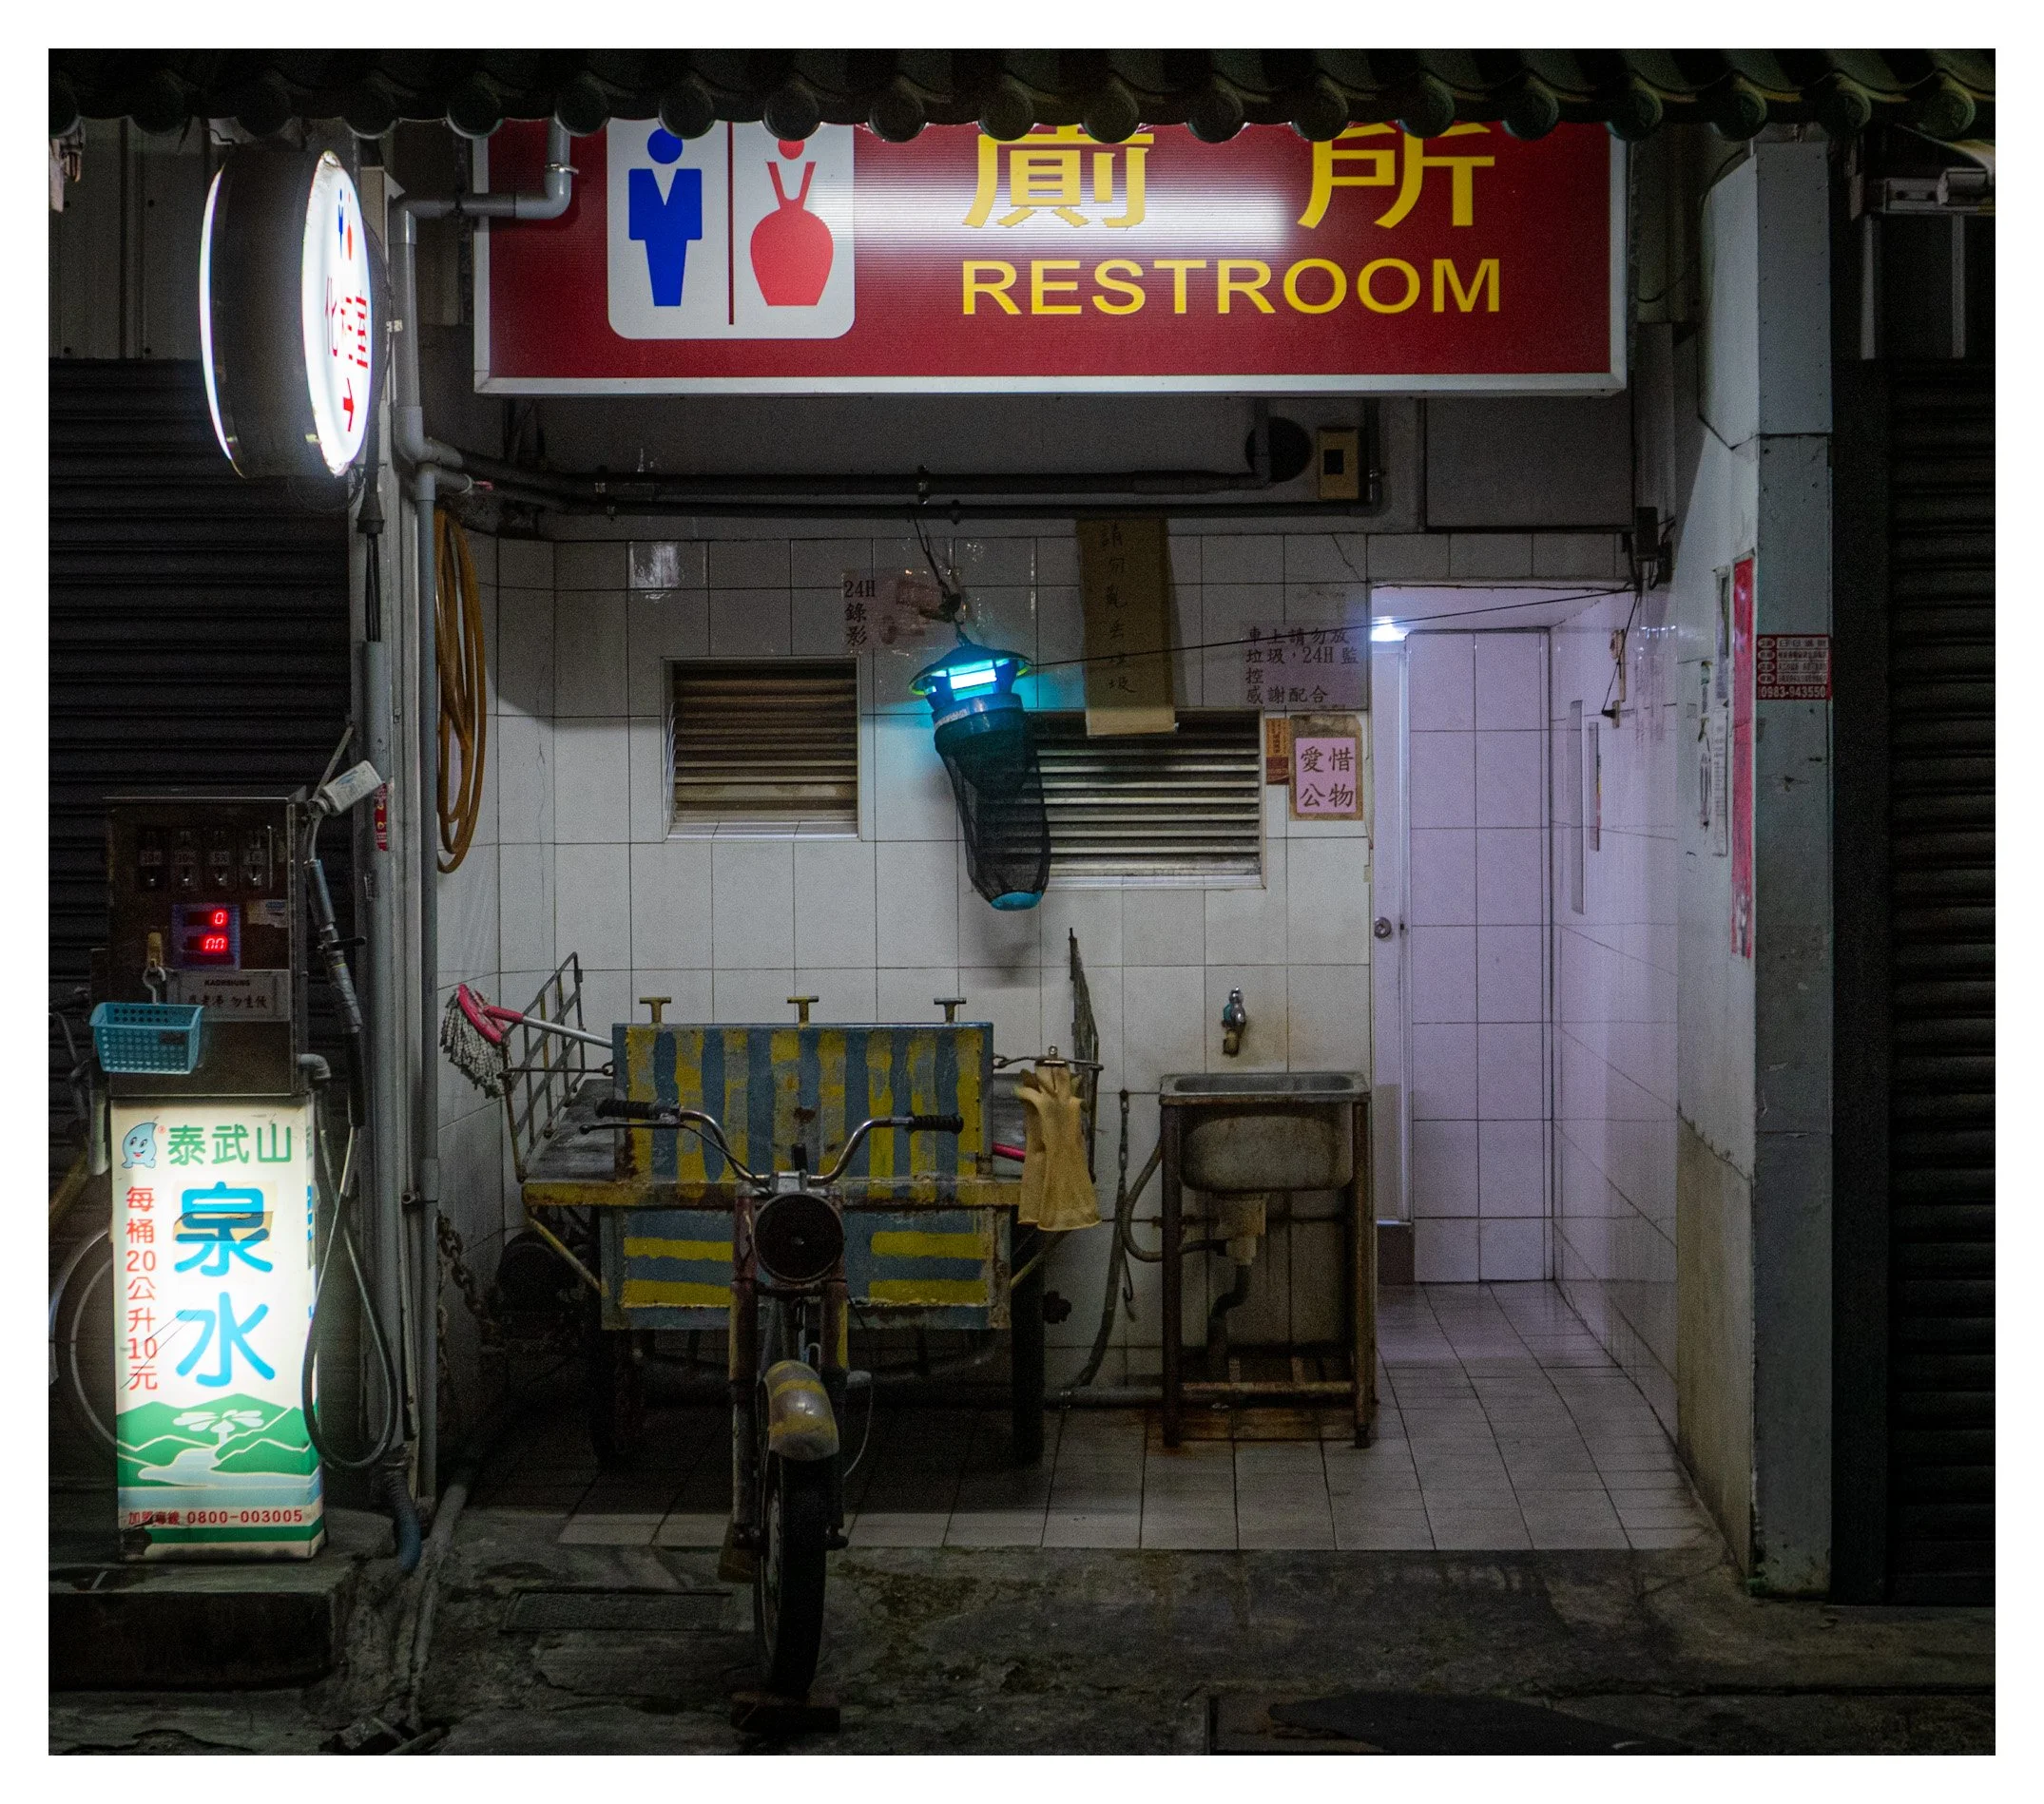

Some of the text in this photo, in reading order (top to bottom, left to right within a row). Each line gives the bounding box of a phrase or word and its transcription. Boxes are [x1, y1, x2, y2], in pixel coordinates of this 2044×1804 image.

[963, 259, 1501, 316] RESTROOM
[843, 579, 876, 598] 24H
[1246, 685, 1328, 704] 感謝配合
[1761, 684, 1826, 699] 0983-943550
[1300, 744, 1355, 774] 愛惜
[1300, 782, 1355, 808] 公物
[214, 912, 225, 928] 0
[168, 1124, 293, 1167] 泰武山
[175, 1181, 275, 1388] 泉水
[186, 1508, 303, 1526] 0800-003005
